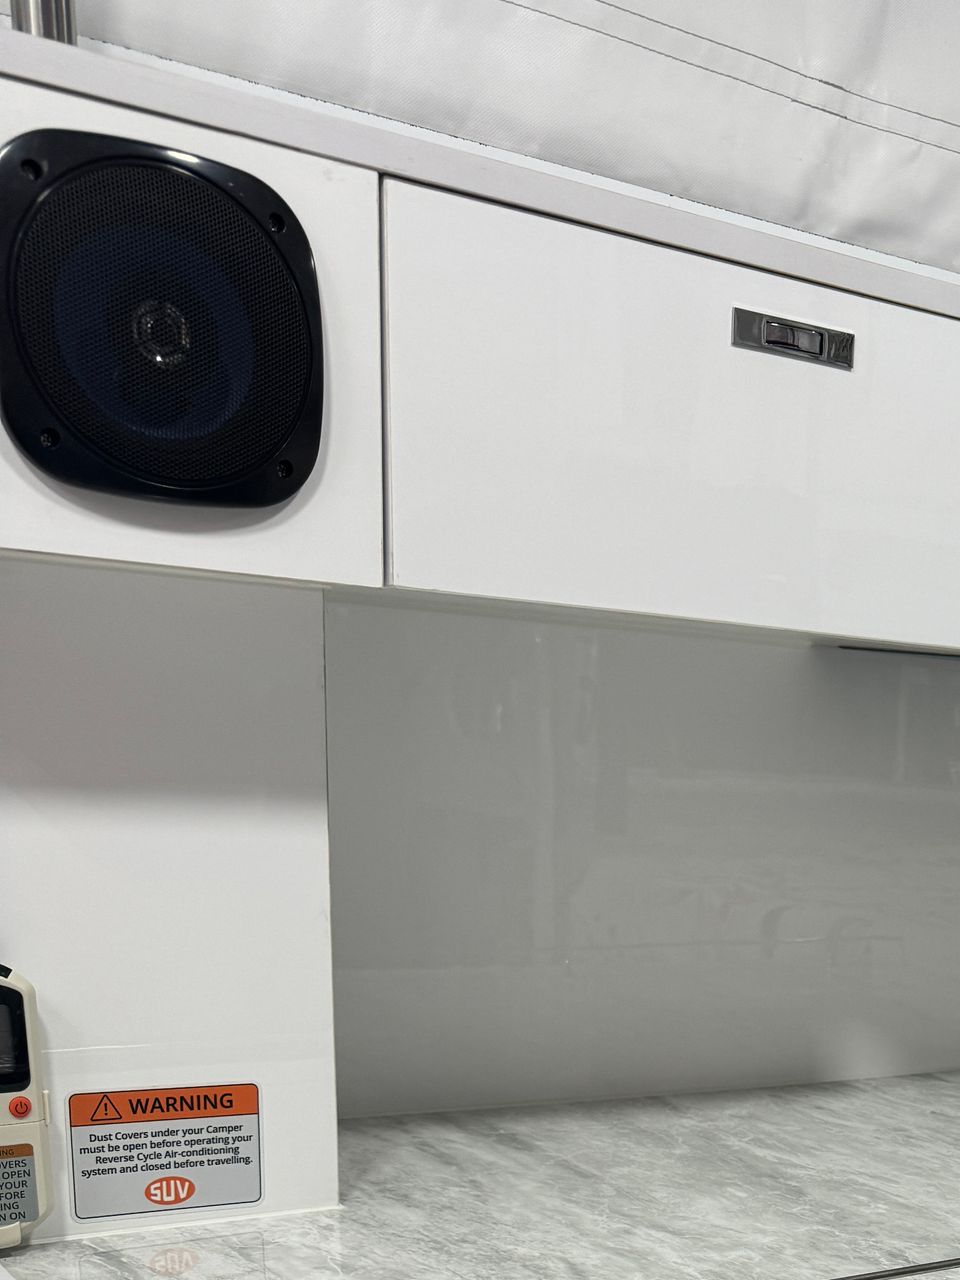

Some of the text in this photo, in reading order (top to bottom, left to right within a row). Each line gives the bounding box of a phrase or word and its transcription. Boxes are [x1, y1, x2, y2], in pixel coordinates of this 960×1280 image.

[128, 1092, 233, 1115] WARNING
[88, 1122, 243, 1142] Dust Covers under your Camper
[79, 1134, 253, 1154] must be open before operating your
[95, 1144, 239, 1164] Reverse Cycle Air-conditioning
[0, 1159, 27, 1169] VERS
[81, 1153, 253, 1178] system and closed before travelling.
[2, 1169, 31, 1180] OPEN
[0, 1180, 28, 1190] YOUR
[149, 1180, 190, 1202] SUV
[9, 1211, 26, 1220] ON
